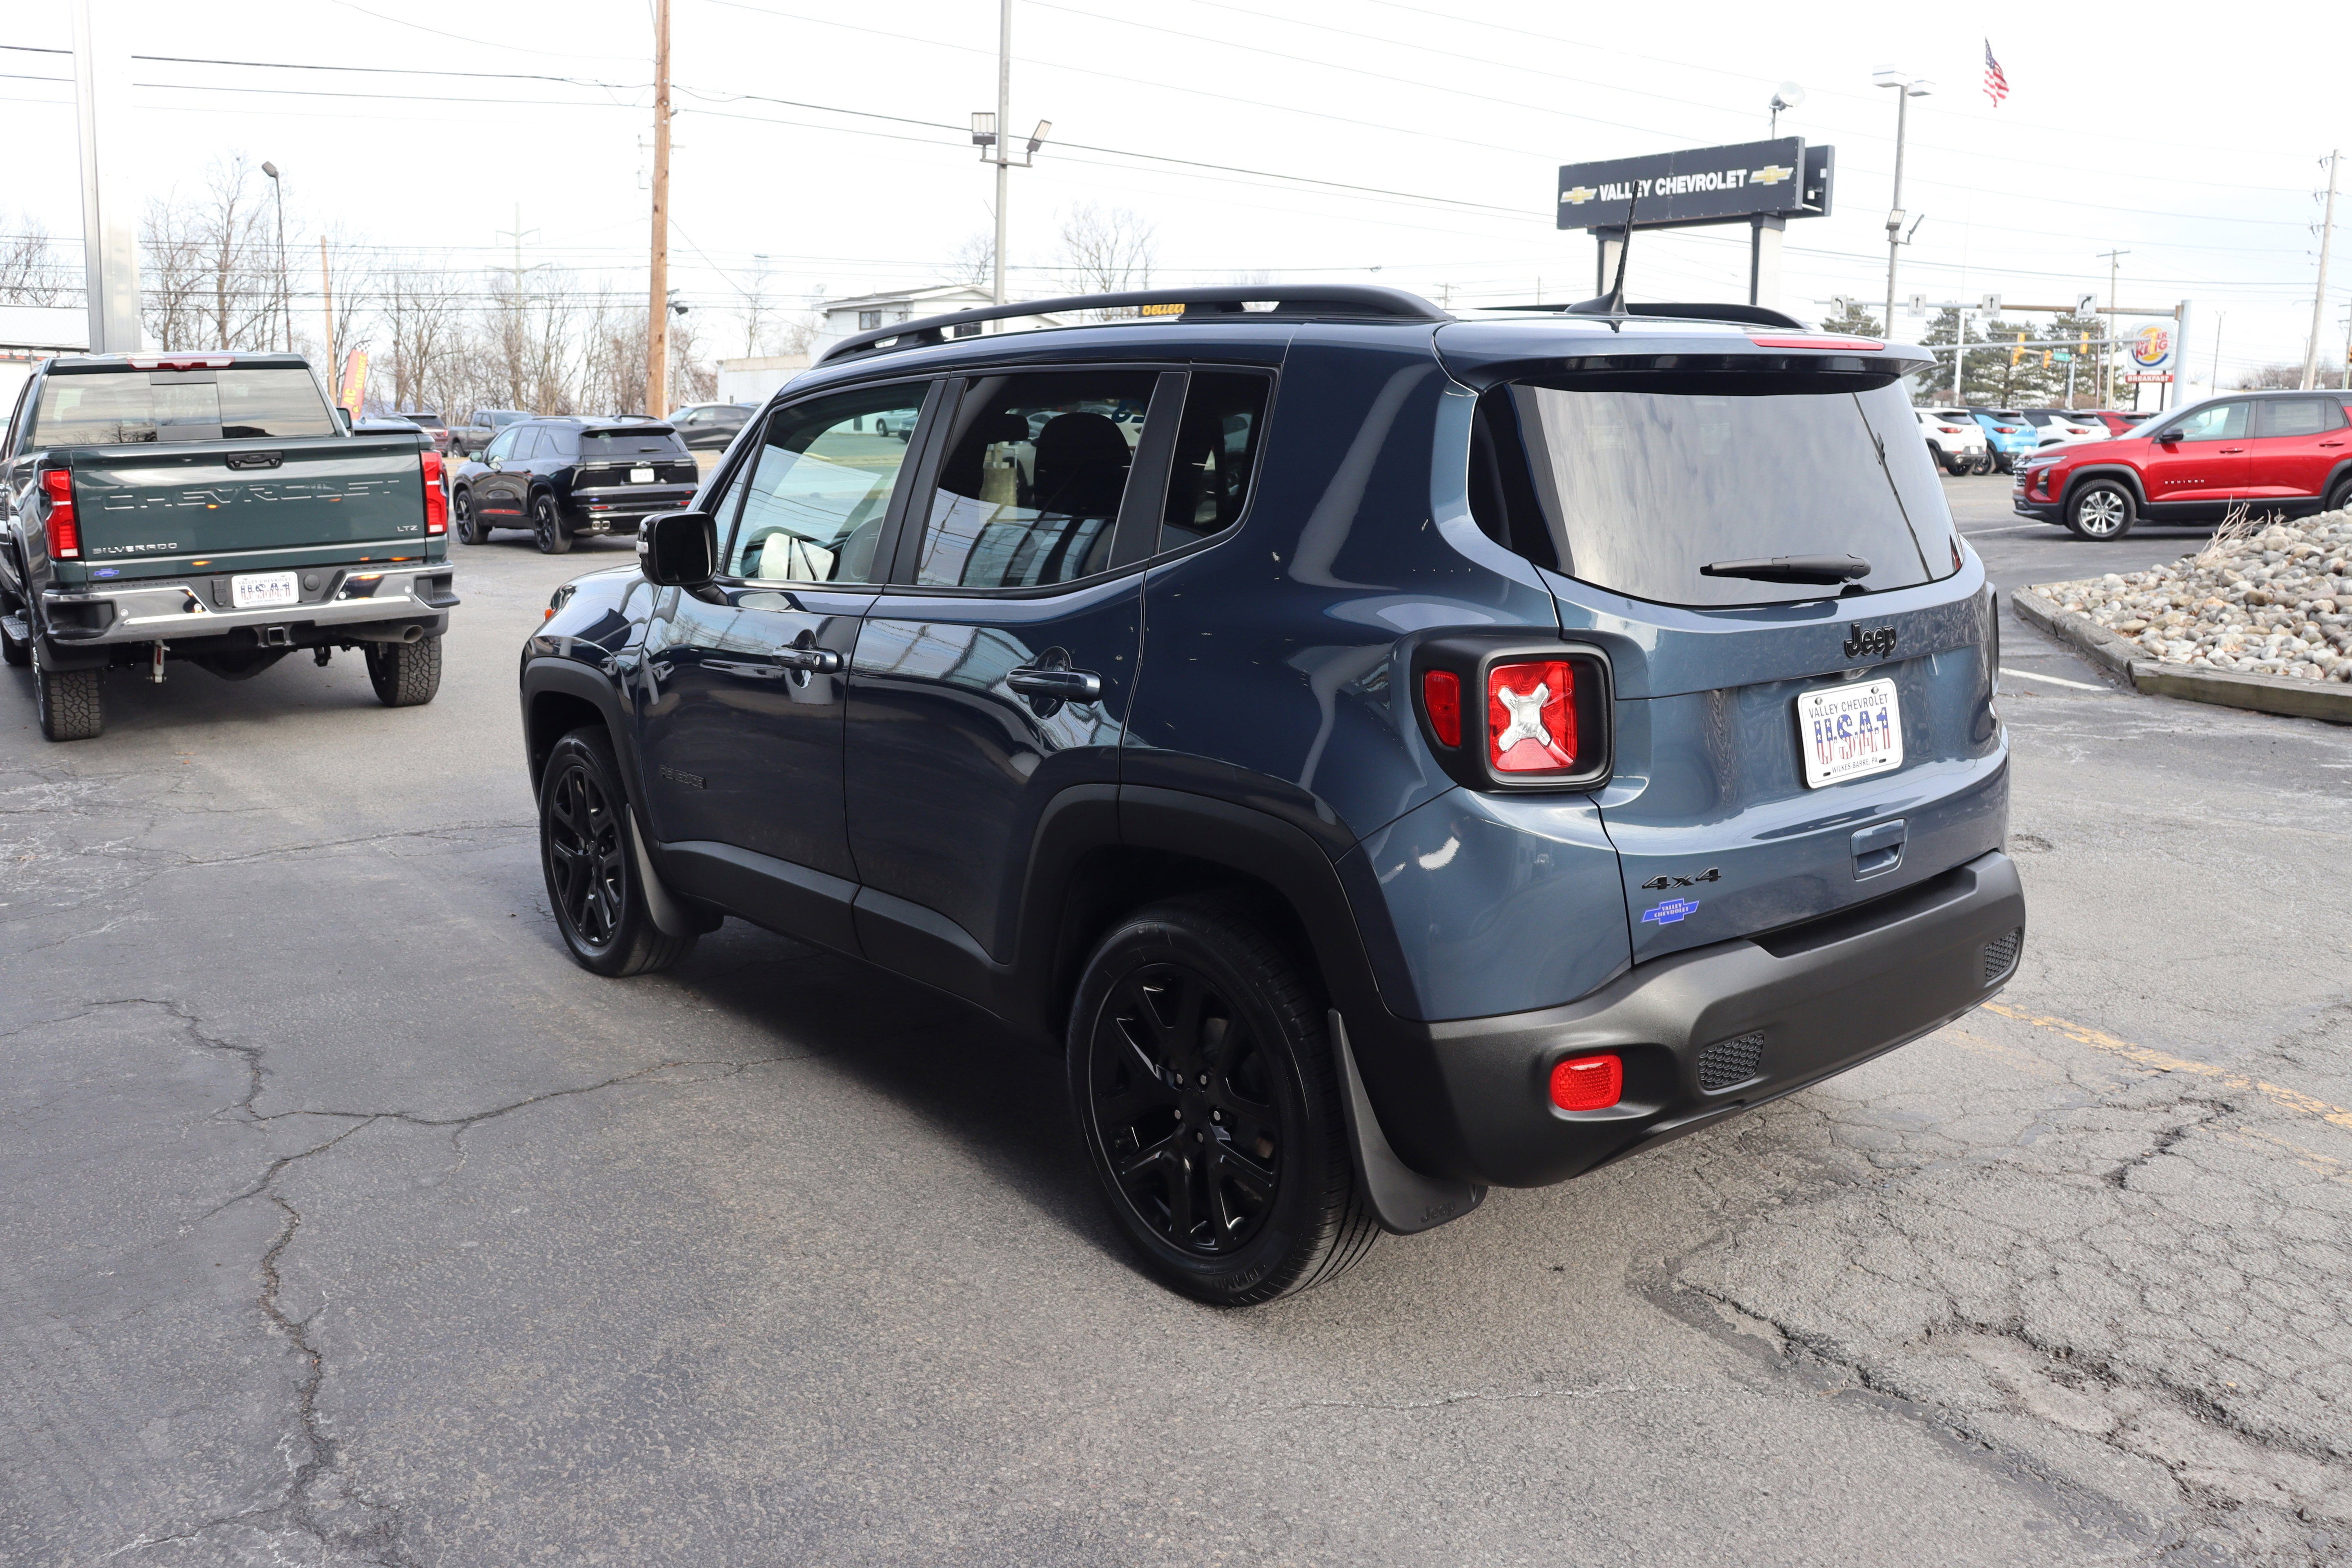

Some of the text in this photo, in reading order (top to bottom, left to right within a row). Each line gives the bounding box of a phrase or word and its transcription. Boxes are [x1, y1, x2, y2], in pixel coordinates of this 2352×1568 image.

[1655, 169, 1747, 196] CHEVROLET
[355, 354, 367, 389] SERVICE
[92, 543, 177, 554] SILVERADO
[1844, 622, 1897, 658] Jeep
[1809, 693, 1888, 719] VALLEY CHEVROLET
[1654, 906, 1689, 918] CHEVROLET
[1661, 903, 1682, 911] VALLEY
[1420, 1200, 1456, 1223] Jeep
